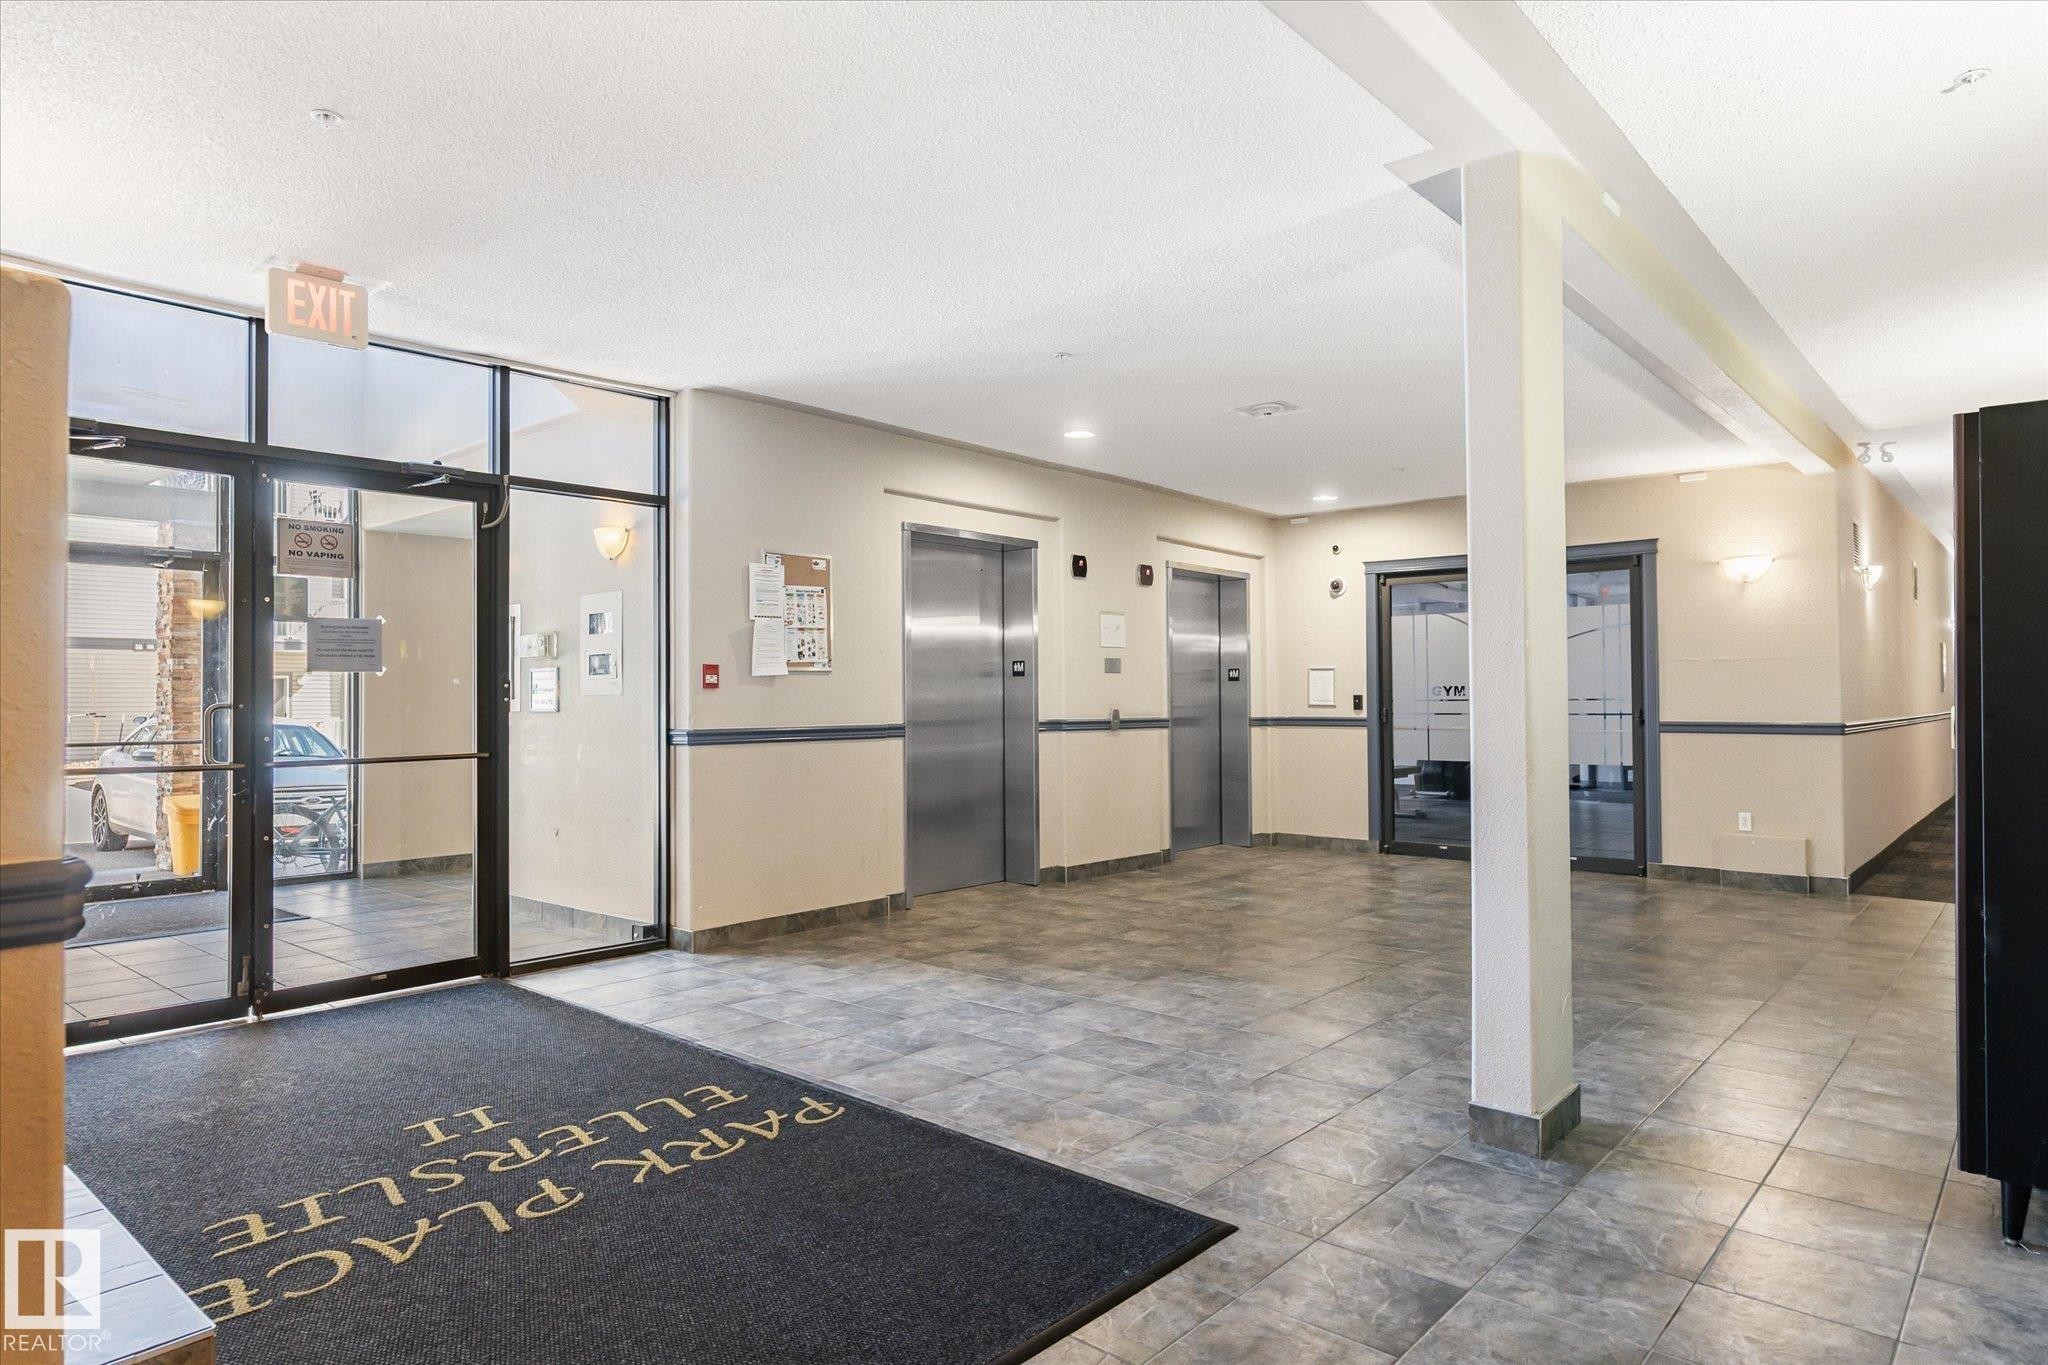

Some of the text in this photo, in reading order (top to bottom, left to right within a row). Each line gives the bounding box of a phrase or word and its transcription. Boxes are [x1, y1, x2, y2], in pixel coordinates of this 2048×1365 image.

[287, 278, 355, 336] EXIT
[288, 523, 345, 534] NO SMOKING
[288, 549, 345, 560] NO VAPING
[1431, 685, 1466, 697] GYM
[403, 1105, 513, 1147] II
[203, 1085, 748, 1259] ELLERSLIE
[187, 1096, 846, 1323] PARK PLACE
